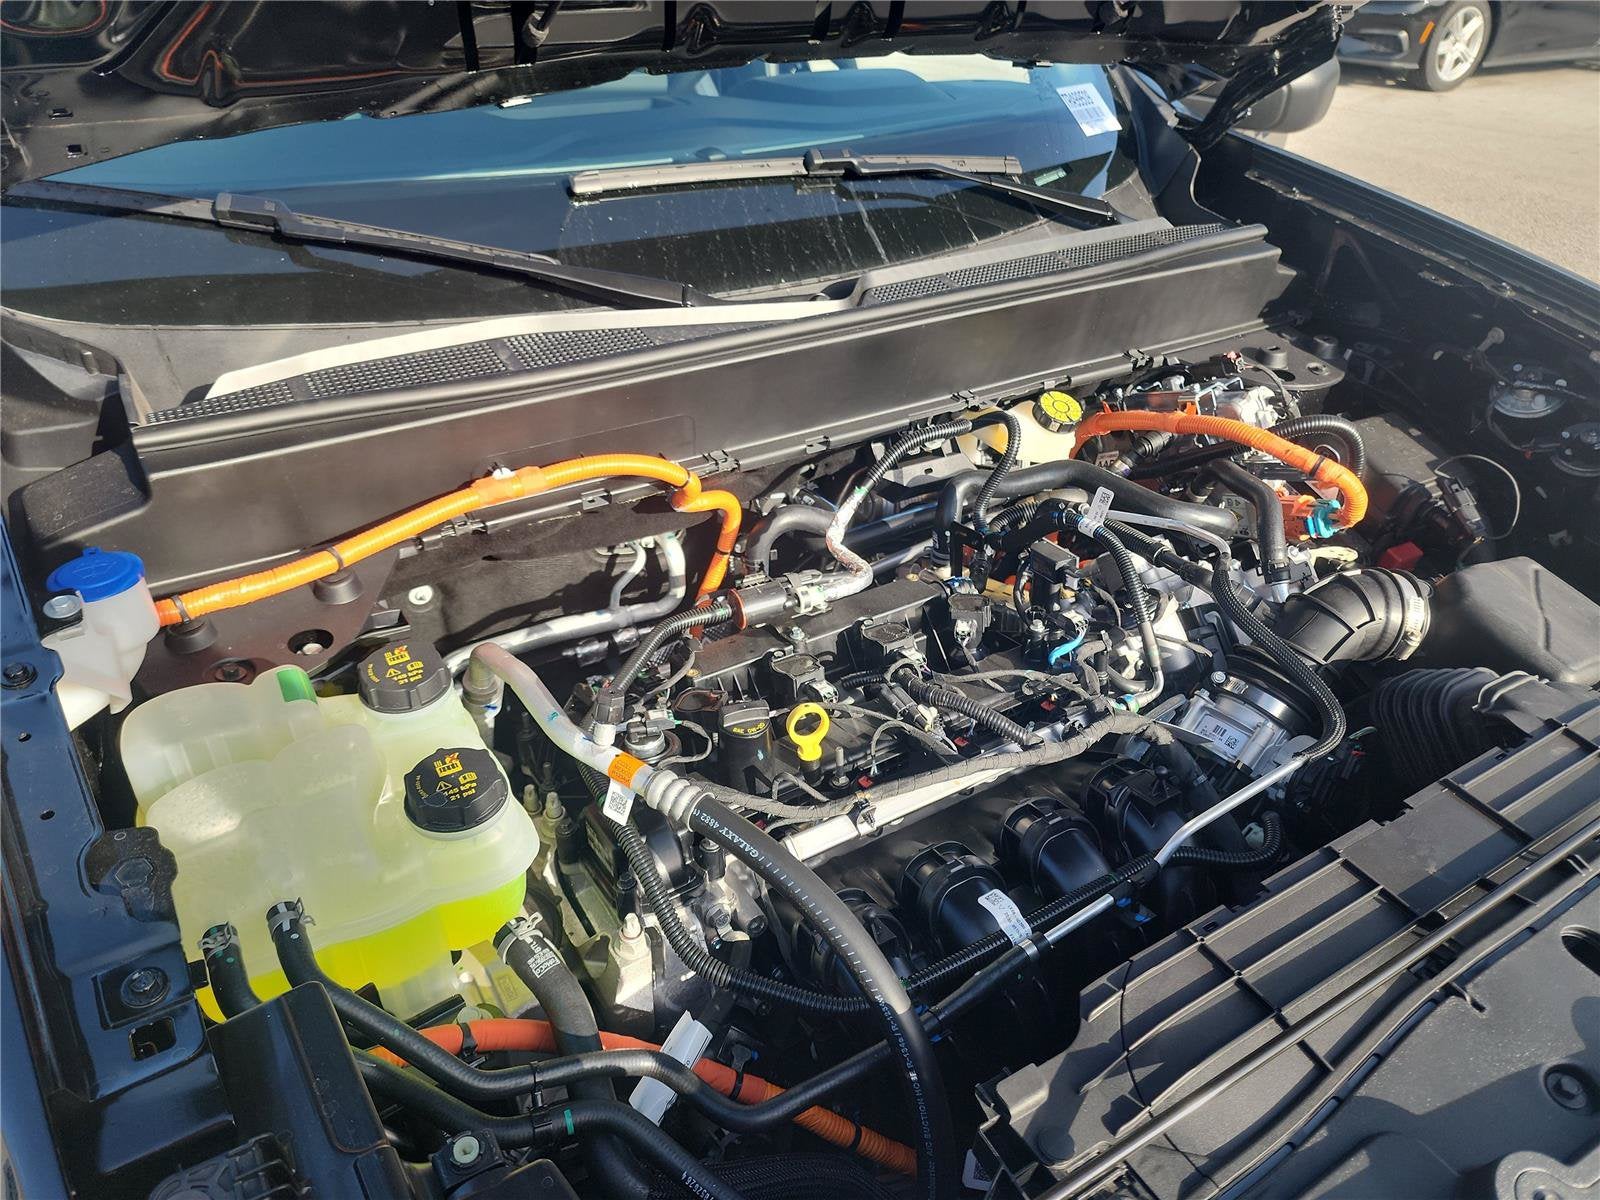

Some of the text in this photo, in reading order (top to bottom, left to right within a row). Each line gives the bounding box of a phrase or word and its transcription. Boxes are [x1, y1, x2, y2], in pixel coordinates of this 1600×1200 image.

[443, 782, 478, 797] 145 kPa
[449, 788, 476, 802] 21 psi
[700, 812, 720, 829] 4882
[719, 827, 759, 858] GALAXY
